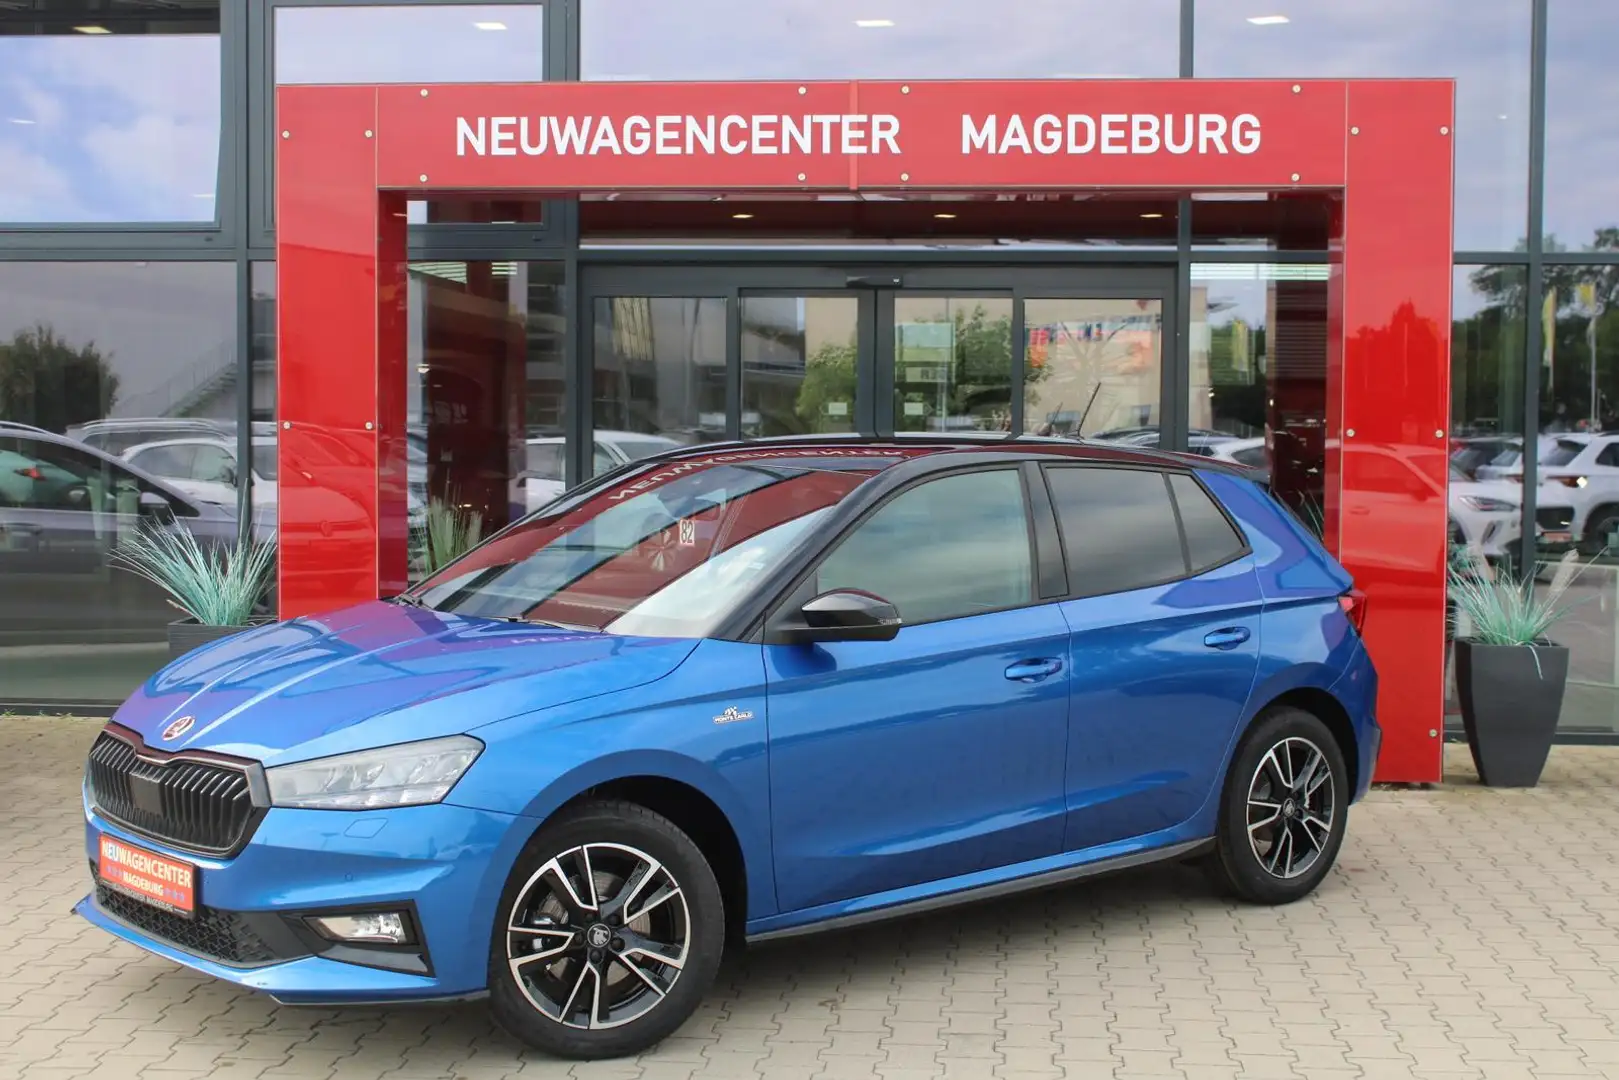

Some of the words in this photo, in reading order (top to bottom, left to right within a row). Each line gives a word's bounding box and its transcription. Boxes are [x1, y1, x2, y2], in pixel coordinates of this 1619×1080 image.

[456, 114, 901, 155] NEUWAGENCENTER
[961, 113, 1261, 154] MAGDEBURG
[681, 520, 694, 544] 82
[101, 839, 193, 888] NEUWAGENCENTER
[122, 870, 164, 897] MAGDEBURG
